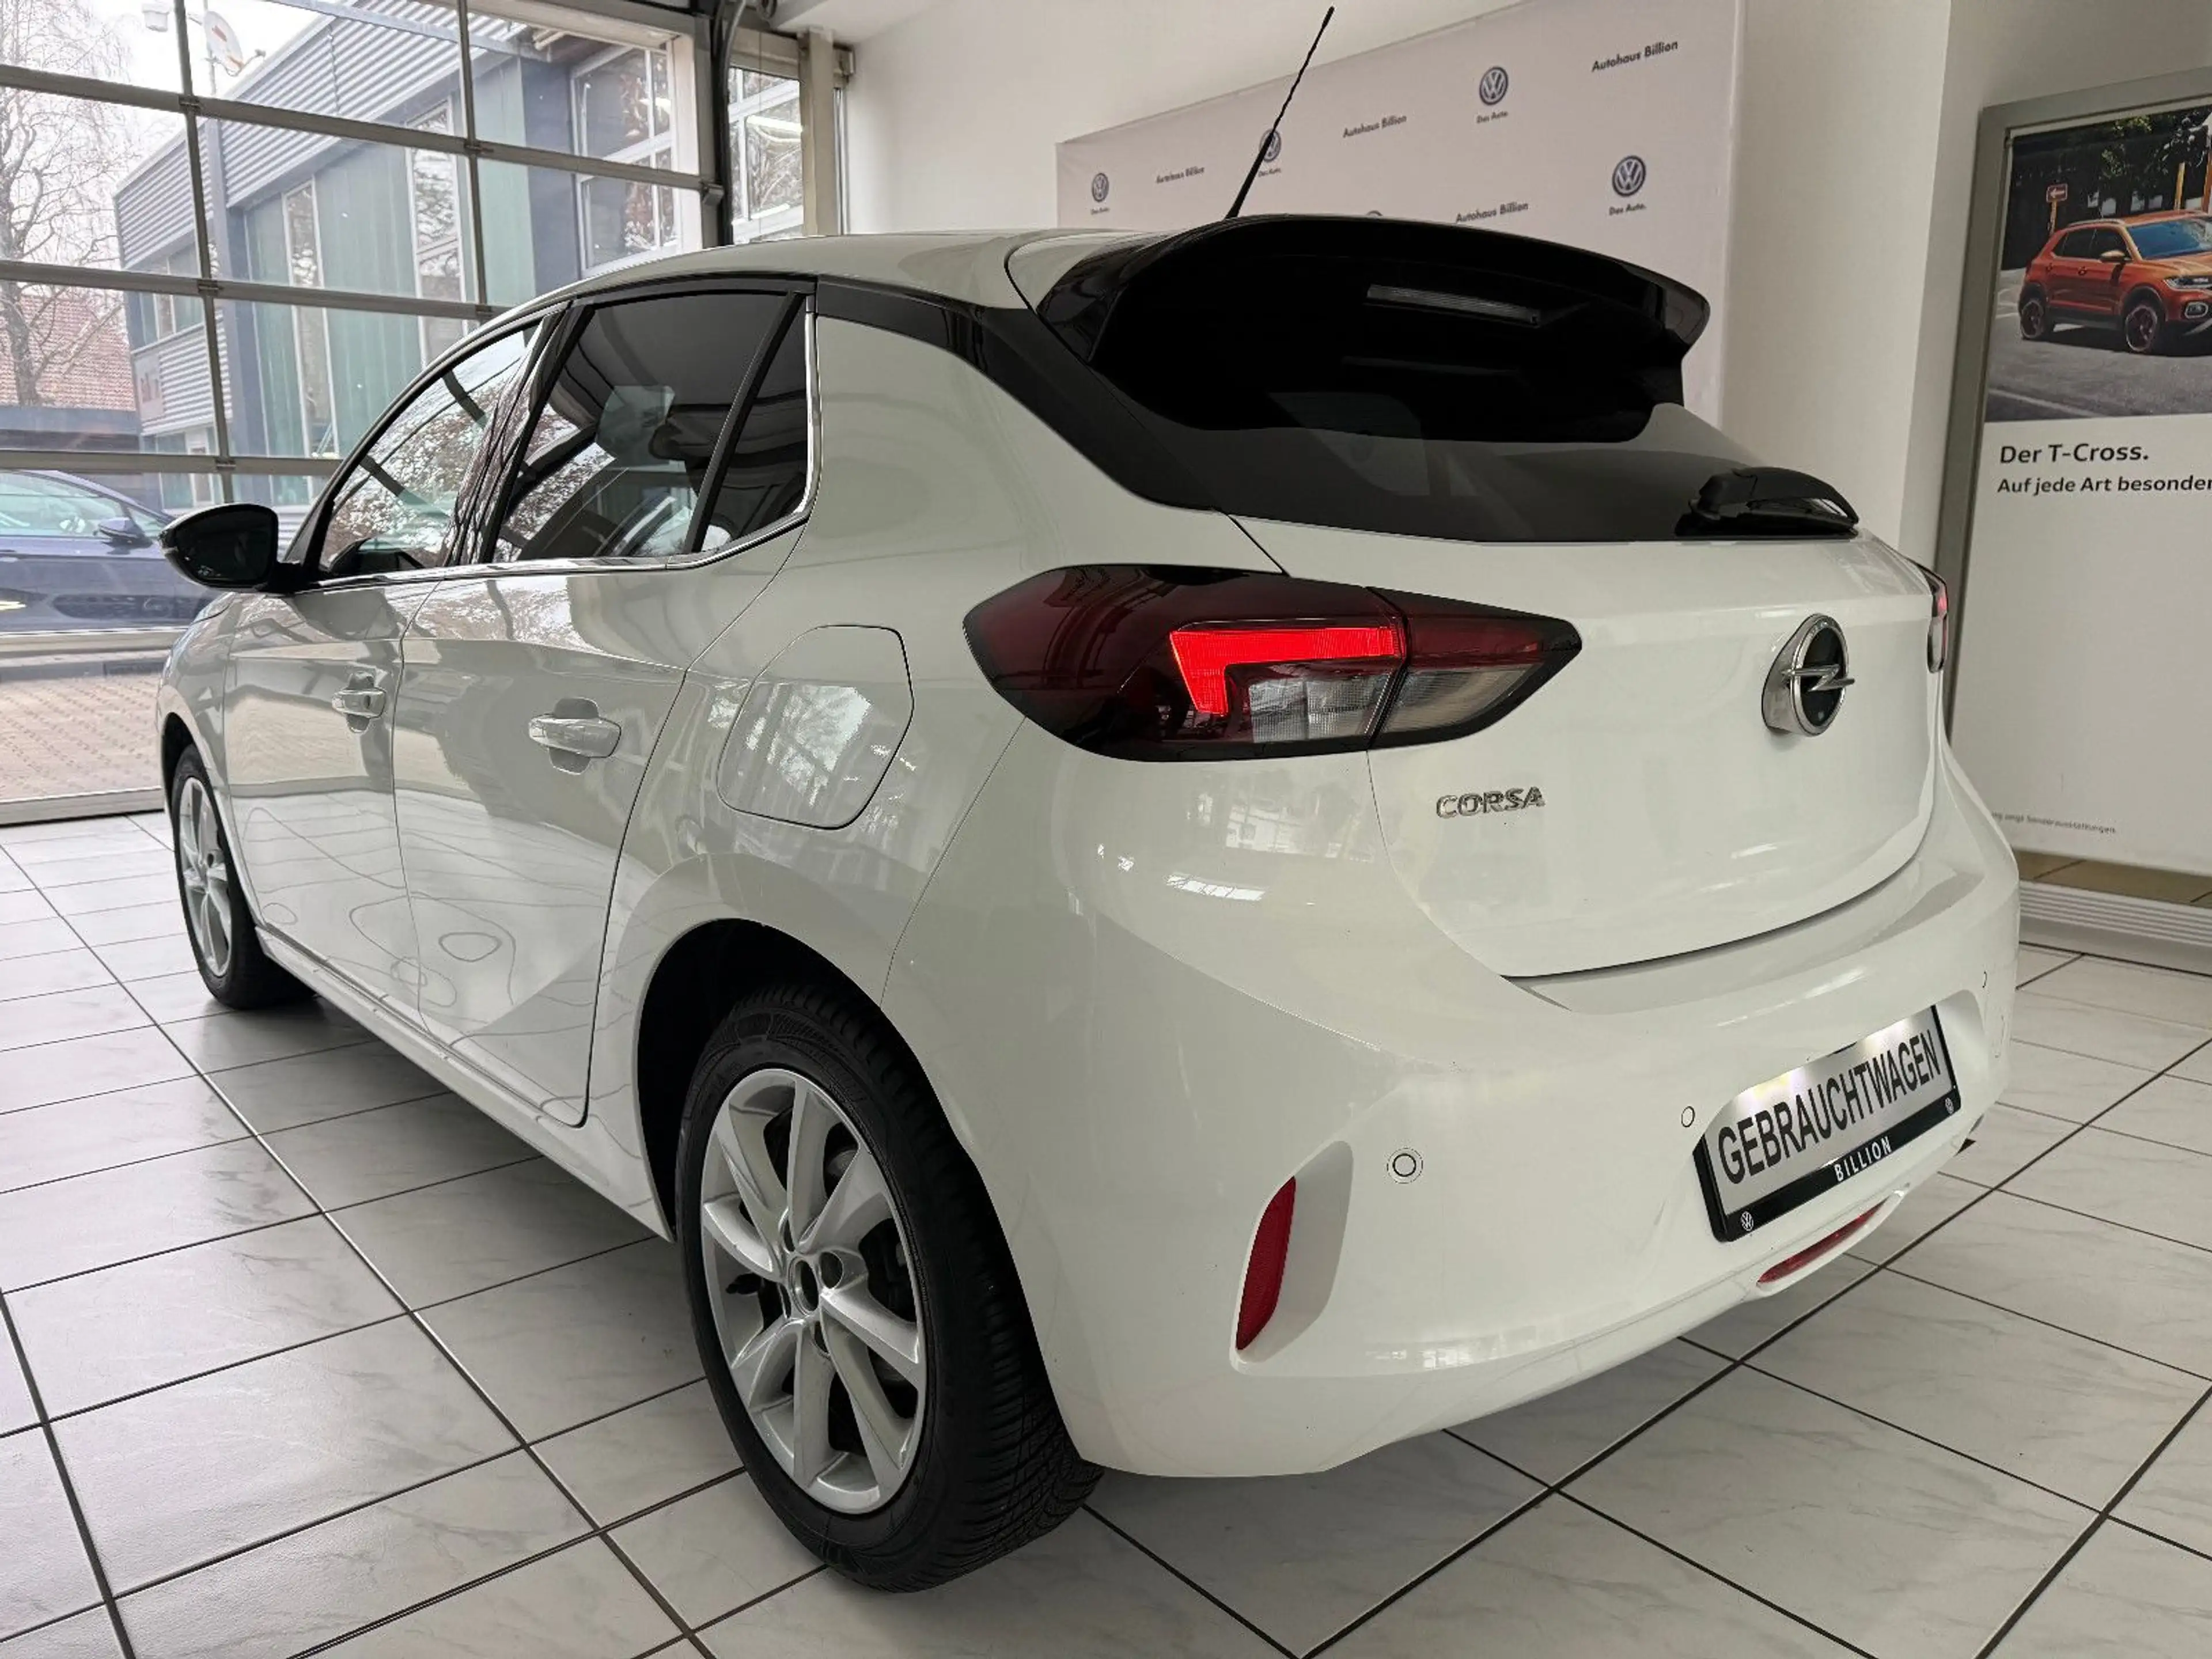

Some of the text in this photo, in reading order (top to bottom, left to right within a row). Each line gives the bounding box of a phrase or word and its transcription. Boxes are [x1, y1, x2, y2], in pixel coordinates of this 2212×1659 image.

[1592, 41, 1678, 73] Autohaus Billion
[2000, 443, 2149, 464] Der T-Cross.
[1997, 478, 2031, 493] Auf
[2033, 477, 2075, 496] jede
[2080, 477, 2112, 492] Art
[1436, 786, 1546, 819] CORSA
[1717, 1029, 1941, 1184] GEBRAUCHTWAGEN
[1834, 1135, 1892, 1181] BILLION
